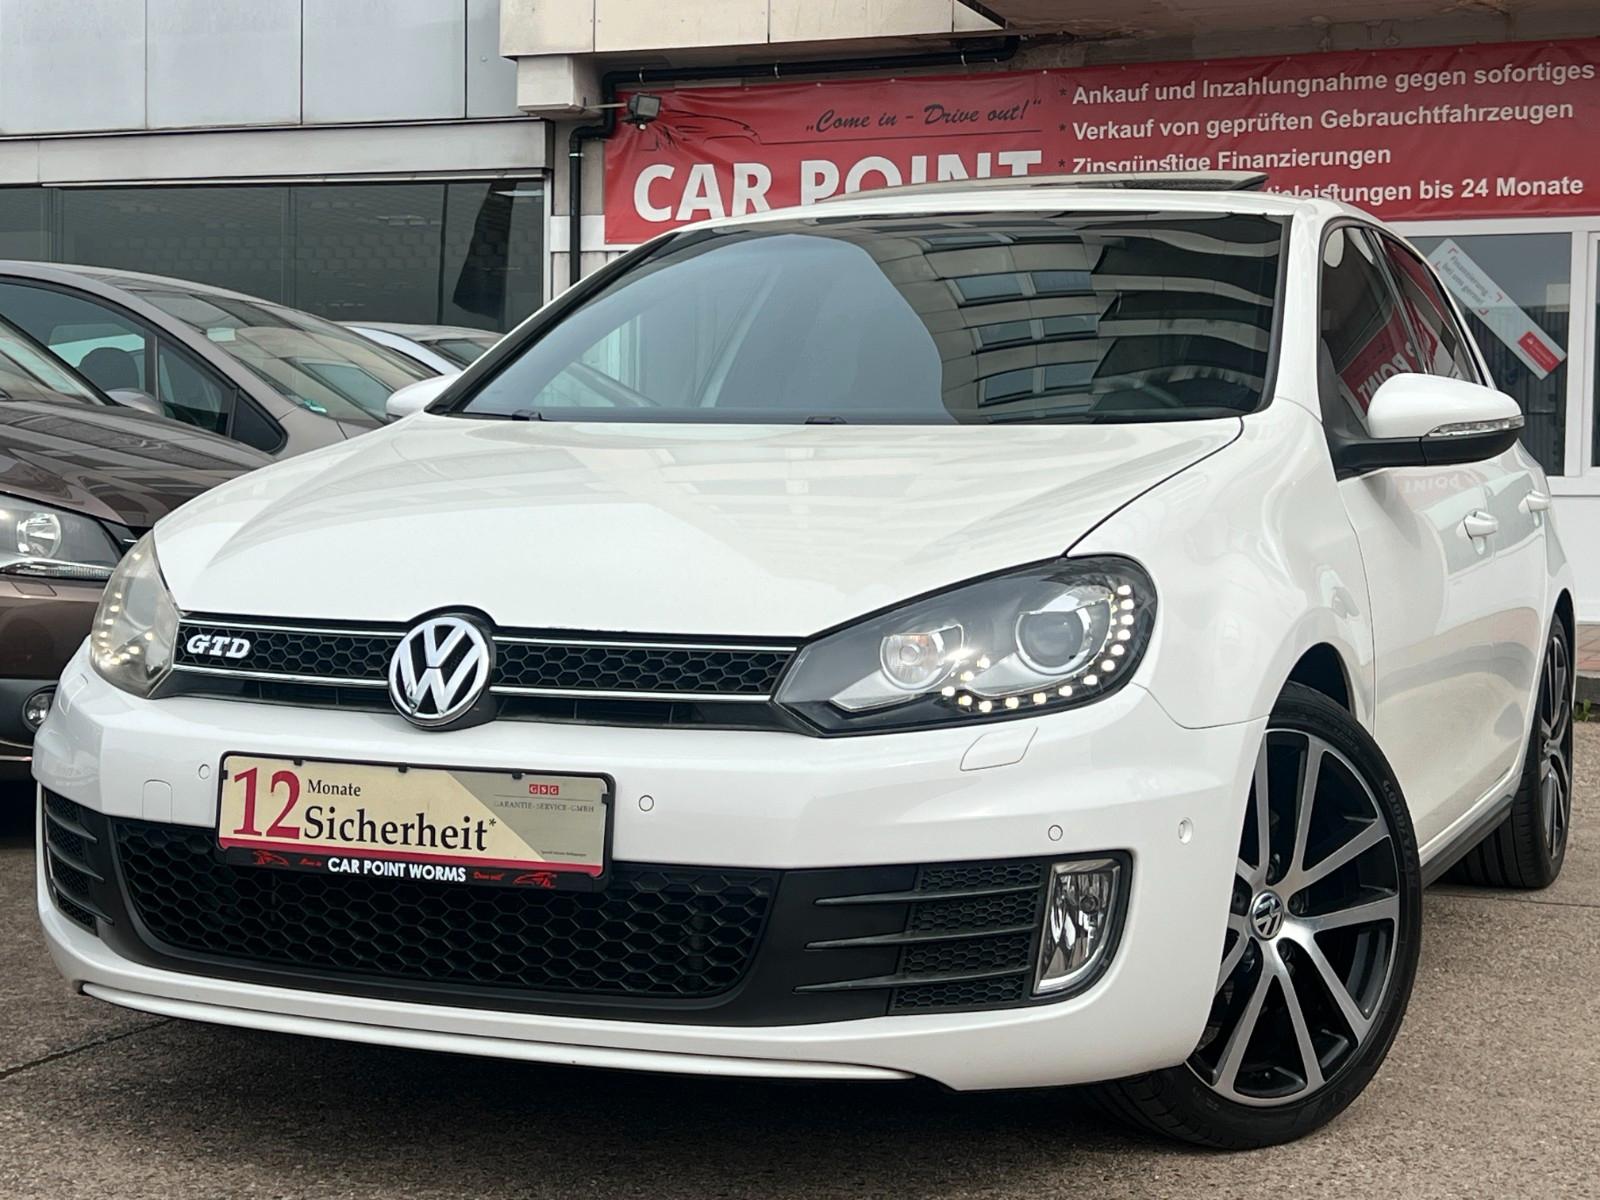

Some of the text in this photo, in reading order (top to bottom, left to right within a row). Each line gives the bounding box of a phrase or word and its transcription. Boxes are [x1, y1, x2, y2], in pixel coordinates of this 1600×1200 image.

[1072, 62, 1595, 105] Ankauf und Inzahlungnahme gegen sofortiges
[878, 111, 897, 127] in
[924, 104, 980, 125] Drive
[1072, 103, 1574, 141] Verkauf von geprüften Gebrauchtfahrzeugen
[1218, 148, 1391, 171] Finanzierungen
[633, 162, 774, 222] CAR
[1419, 180, 1454, 199] bis
[1460, 178, 1489, 198] 24
[1496, 176, 1584, 197] Monate
[187, 634, 250, 659] GTD
[529, 784, 559, 795] GSG
[233, 767, 361, 839] 12 Monate
[328, 857, 360, 874] CAR
[363, 860, 406, 879] POINT
[409, 864, 467, 882] WORMS
